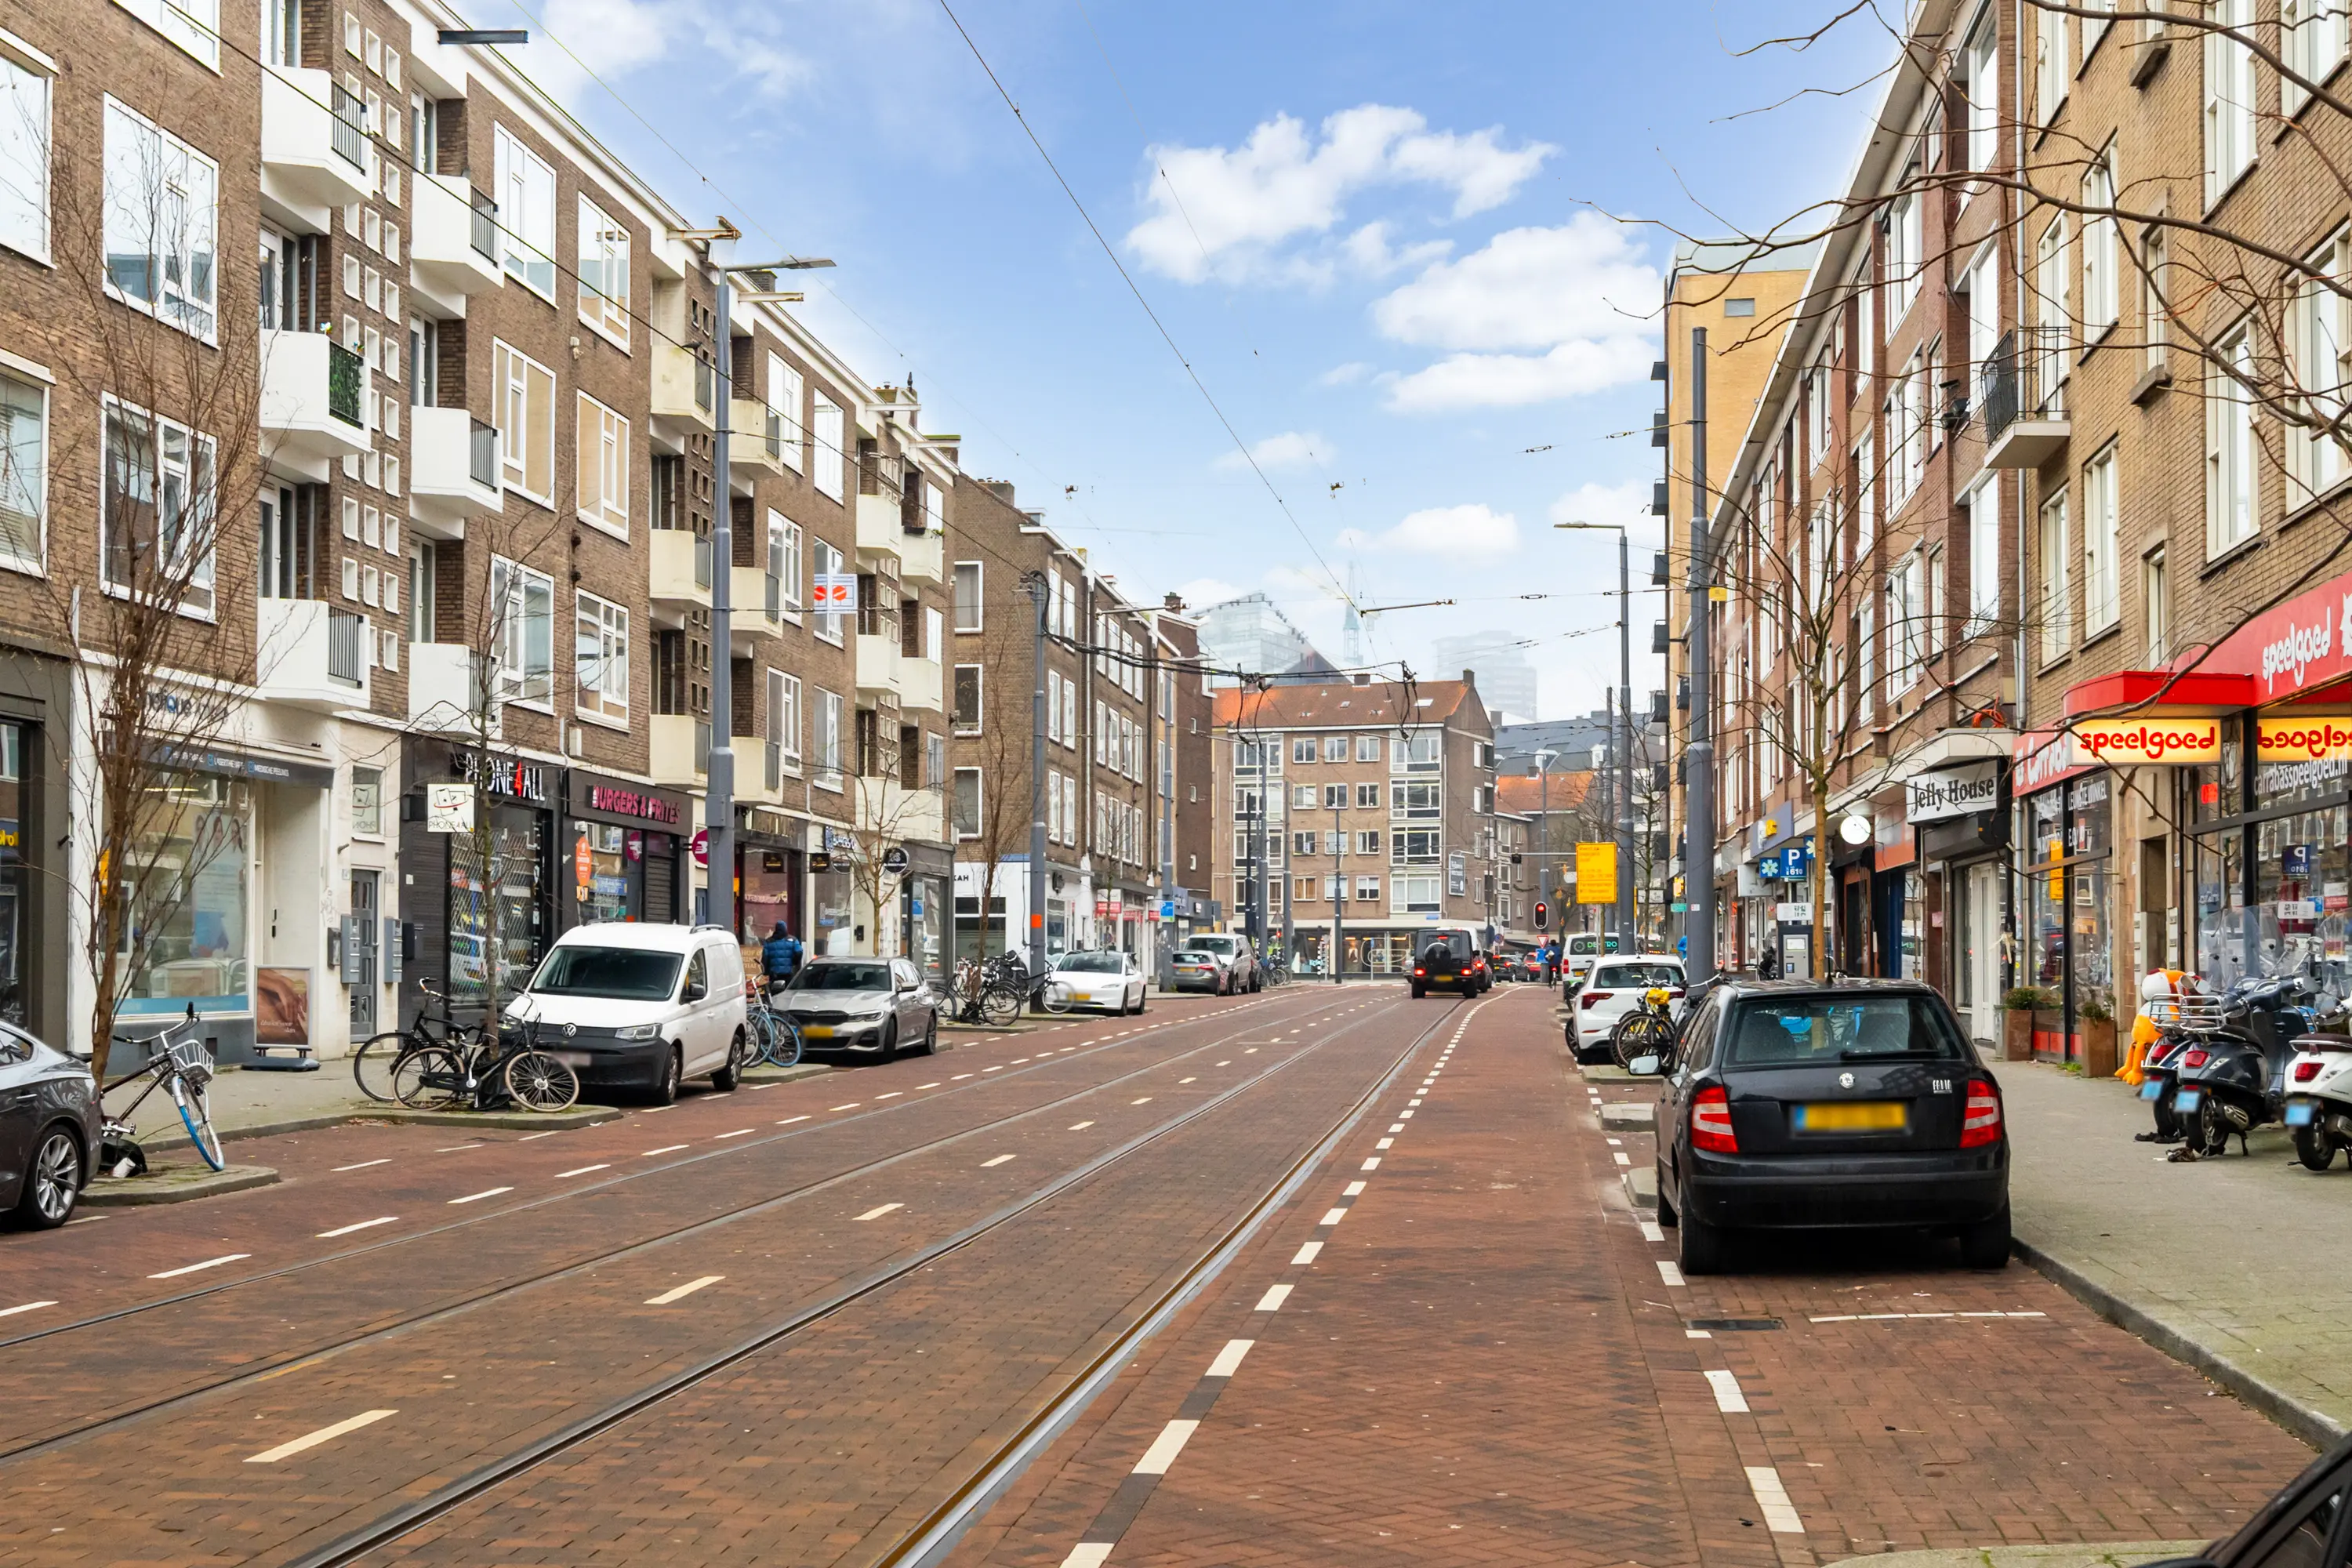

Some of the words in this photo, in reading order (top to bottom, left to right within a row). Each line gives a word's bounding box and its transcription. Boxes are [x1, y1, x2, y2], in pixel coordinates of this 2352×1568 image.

[2262, 605, 2332, 695] speelgoed
[2079, 726, 2216, 760] speelgoed
[592, 784, 639, 816] BURGERS
[647, 797, 681, 824] FRITES
[1912, 781, 1945, 816] Jelly
[1947, 779, 1994, 802] House
[1788, 849, 1800, 866] P
